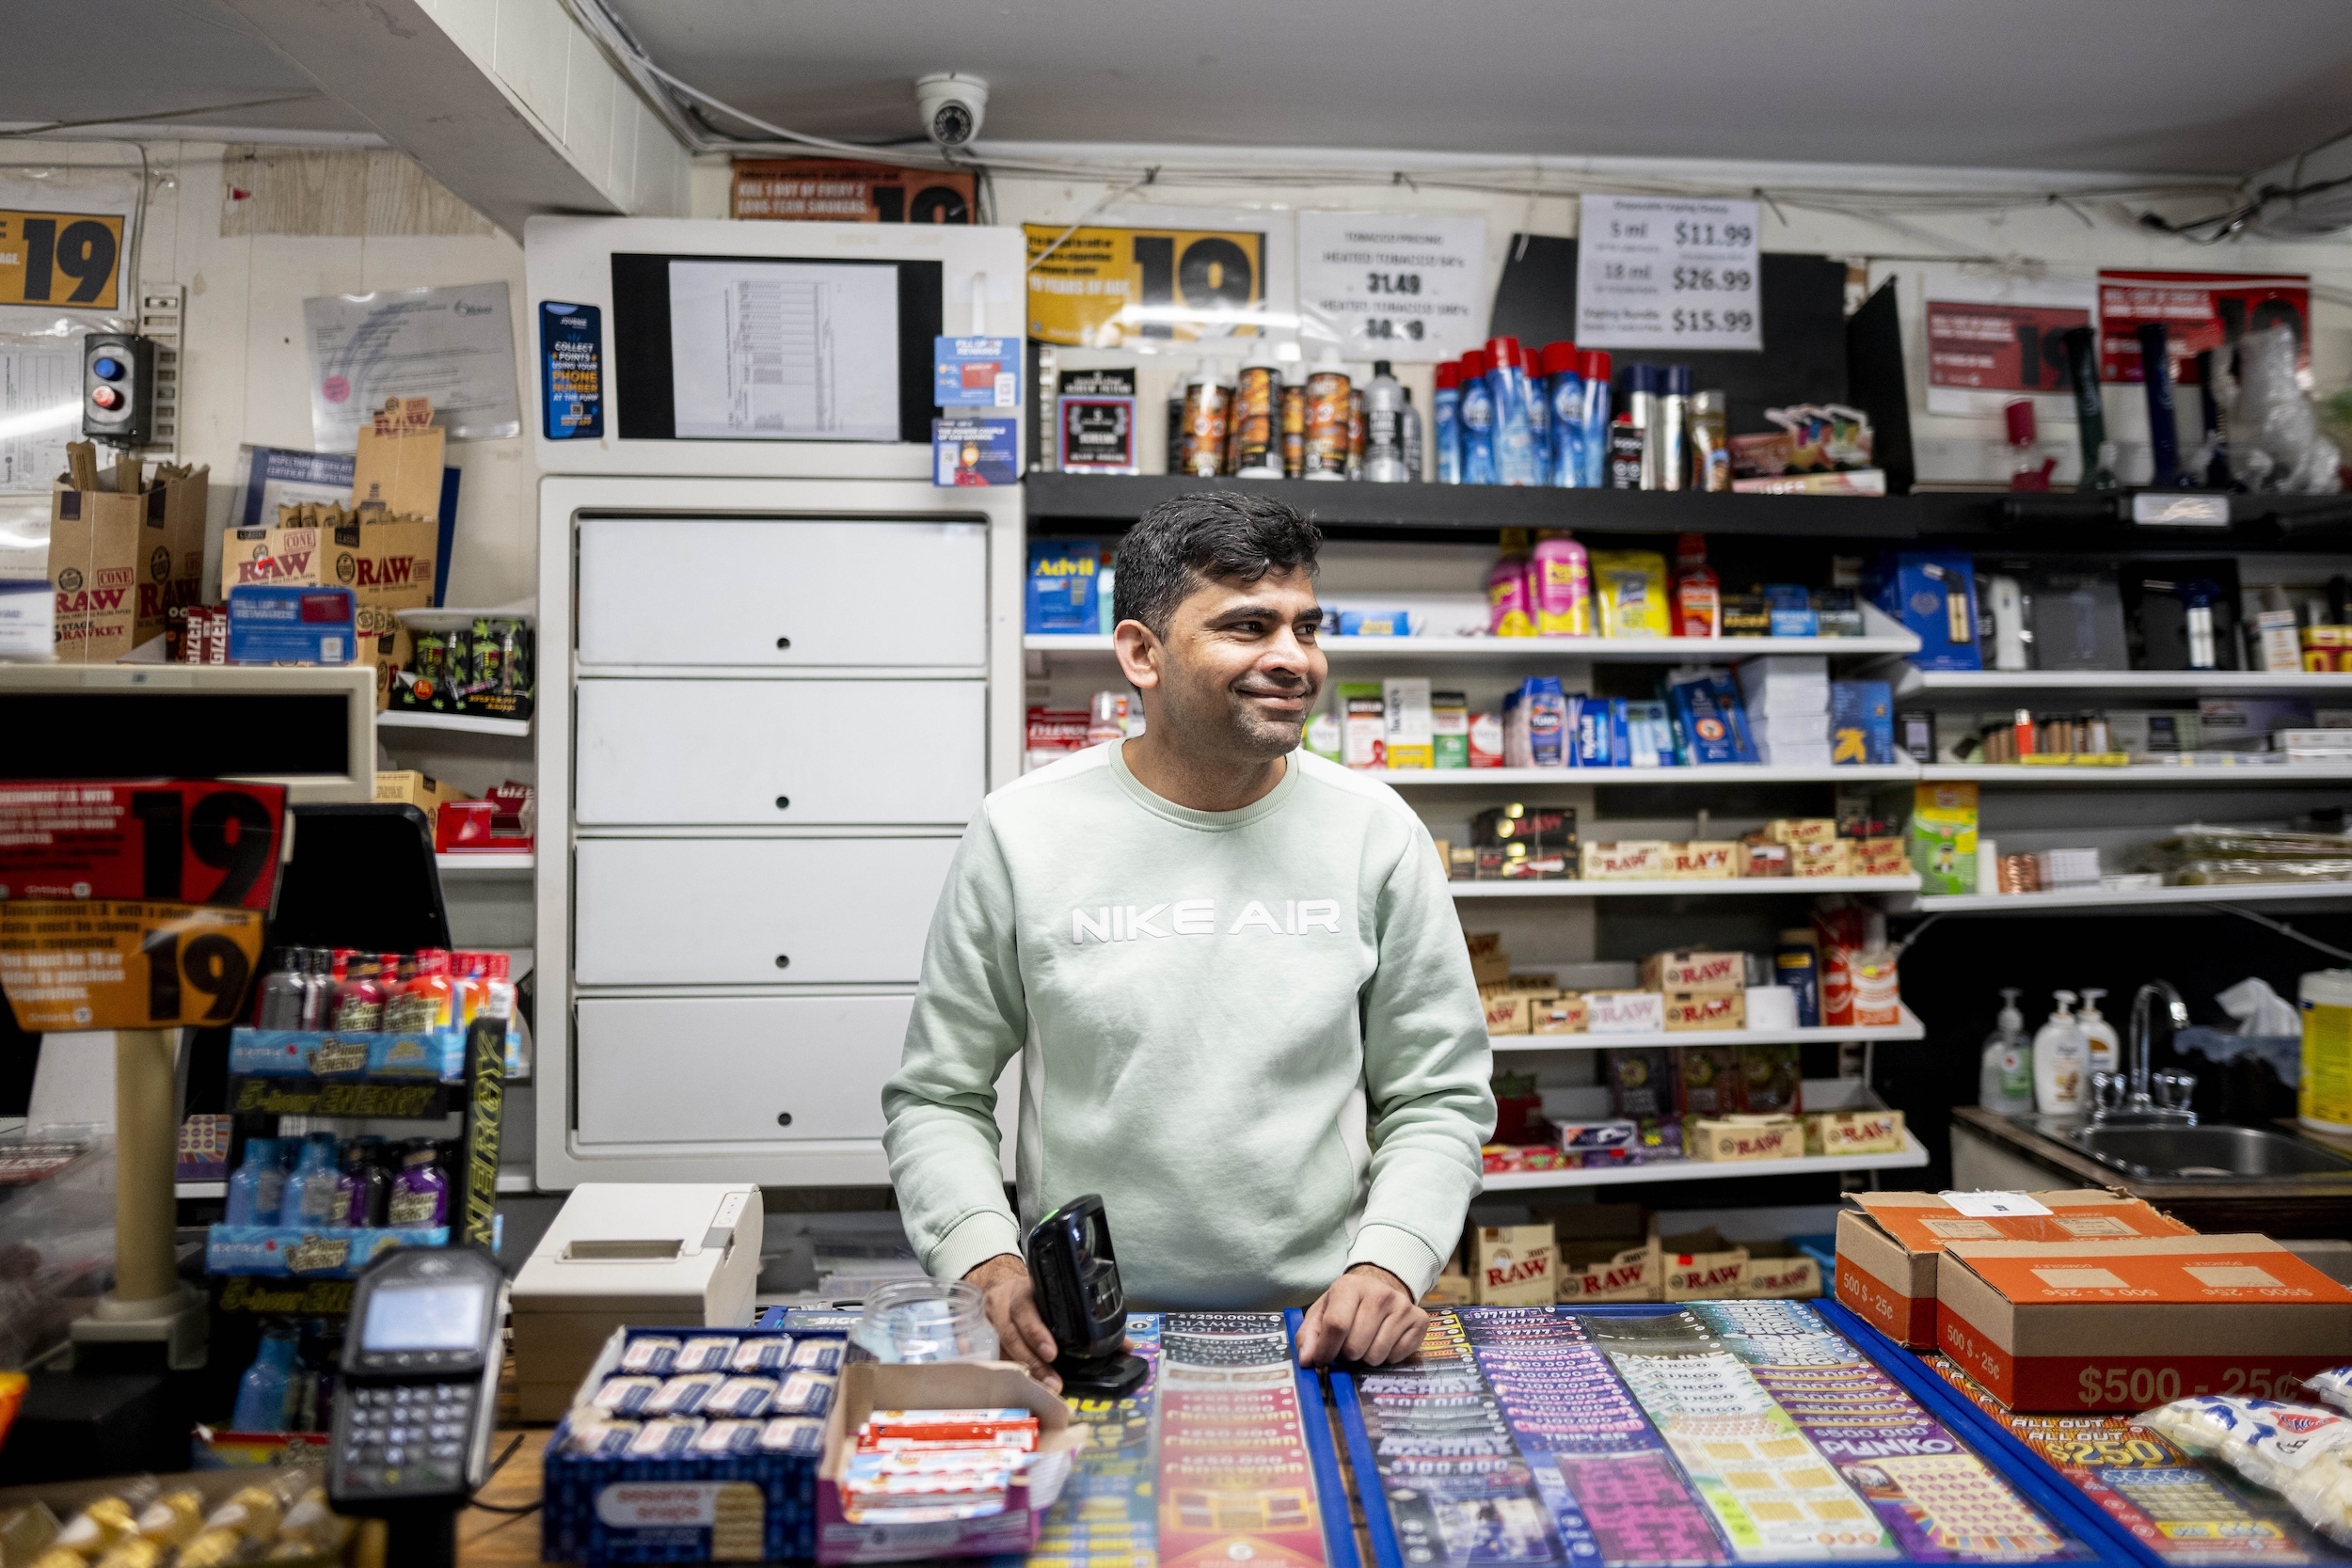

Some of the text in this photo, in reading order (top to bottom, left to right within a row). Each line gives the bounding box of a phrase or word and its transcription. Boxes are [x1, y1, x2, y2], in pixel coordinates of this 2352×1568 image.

[1610, 219, 1648, 238] 5 ml
[1674, 219, 1753, 248] $11.99
[23, 218, 116, 303] 19
[1367, 272, 1421, 295] 31.49
[1673, 264, 1752, 293] $26.99
[1134, 236, 1253, 340] 19
[1673, 307, 1753, 334] $15.99
[554, 341, 595, 353] COLLECT
[558, 352, 591, 362] POINTS
[551, 361, 597, 372] USING YOUR
[551, 371, 597, 384] PHONE
[552, 384, 598, 394] NUMBER
[553, 393, 598, 403] AT THE PUMP
[374, 412, 432, 438] RAW
[268, 455, 354, 472] INSPECTION CERTIFICATE
[285, 533, 314, 550] CONE
[238, 550, 312, 584] RAW
[356, 555, 415, 587] RAW
[1036, 557, 1095, 577] Advil
[100, 568, 133, 585] CONE
[56, 588, 127, 613] RAW
[62, 620, 94, 629] STAGE
[62, 625, 125, 641] RAWKET
[210, 612, 227, 665] GIZEH
[1790, 825, 1821, 840] RAW
[132, 790, 273, 909] 19
[1858, 843, 1893, 858] RAW
[1605, 853, 1646, 872] RAW
[1676, 849, 1728, 872] RAW
[1866, 860, 1901, 875] RAW
[1804, 863, 1836, 878] RAW
[1072, 898, 1342, 944] NIKE AIR
[143, 929, 249, 1022] 19
[1680, 958, 1734, 984] RAW
[1487, 1007, 1516, 1024] AW
[1599, 999, 1657, 1024] RAW
[1682, 999, 1734, 1022] RAW
[238, 1082, 437, 1115] 5-hour ENERGY
[1736, 1132, 1785, 1156] RAW
[1486, 1257, 1548, 1288] RAW
[1582, 1263, 1645, 1294] RAW
[1687, 1264, 1741, 1291] RAW
[1764, 1268, 1810, 1291] RAW
[1842, 1272, 1894, 1321] 500 $ 25¢
[2042, 1287, 2159, 1298] 500 $ 25¢
[2201, 1287, 2313, 1298] $500 25¢
[1168, 1320, 1279, 1328] DIAMOND
[1499, 1348, 1568, 1357] $100,000
[1947, 1323, 2001, 1381] 500 $ 25¢
[1777, 1356, 1841, 1366] BIG
[1511, 1370, 1582, 1379] $100,000
[1654, 1371, 1721, 1380] BINGO
[1359, 1382, 1484, 1395] MACHINE
[1517, 1381, 1590, 1390] $100,000
[1658, 1383, 1725, 1391] BINGO
[2077, 1366, 2182, 1408] $500
[2221, 1367, 2298, 1402] 25¢
[1523, 1392, 1597, 1402] $100,000
[1667, 1393, 1737, 1402] BINGO
[1530, 1402, 1604, 1412] $100,000
[1513, 1418, 1645, 1433] CROSSWORD
[1535, 1415, 1612, 1424] $100,000
[2011, 1418, 2106, 1429] ALL OUT
[1541, 1432, 1629, 1441] TRIPLER
[1813, 1426, 1929, 1439] $500,000
[2027, 1431, 2123, 1442] ALL OUT
[1377, 1444, 1514, 1457] MACHINE
[1817, 1437, 1954, 1457] PLINKO
[2044, 1439, 2166, 1466] $250
[1391, 1459, 1508, 1475] $100,000
